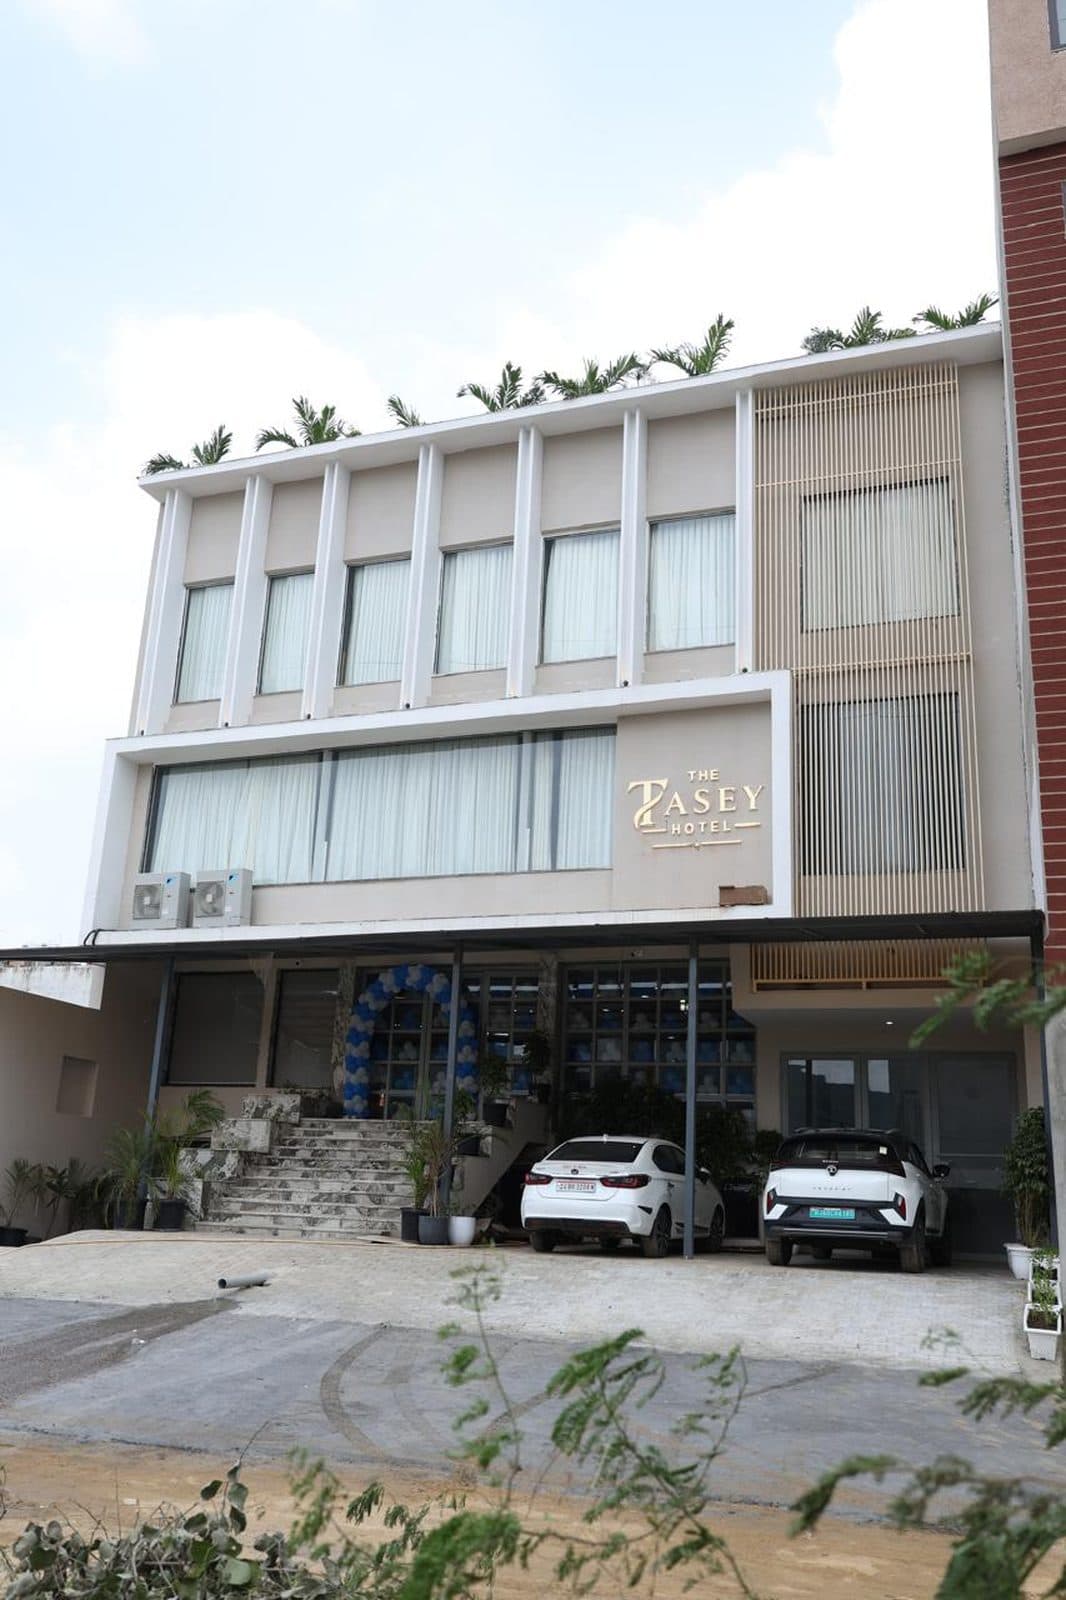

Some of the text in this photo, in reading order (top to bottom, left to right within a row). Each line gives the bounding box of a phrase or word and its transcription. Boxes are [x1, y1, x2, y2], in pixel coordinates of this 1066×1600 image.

[688, 769, 720, 781] THE
[627, 778, 764, 829] TASEY
[671, 820, 731, 835] HOTEL
